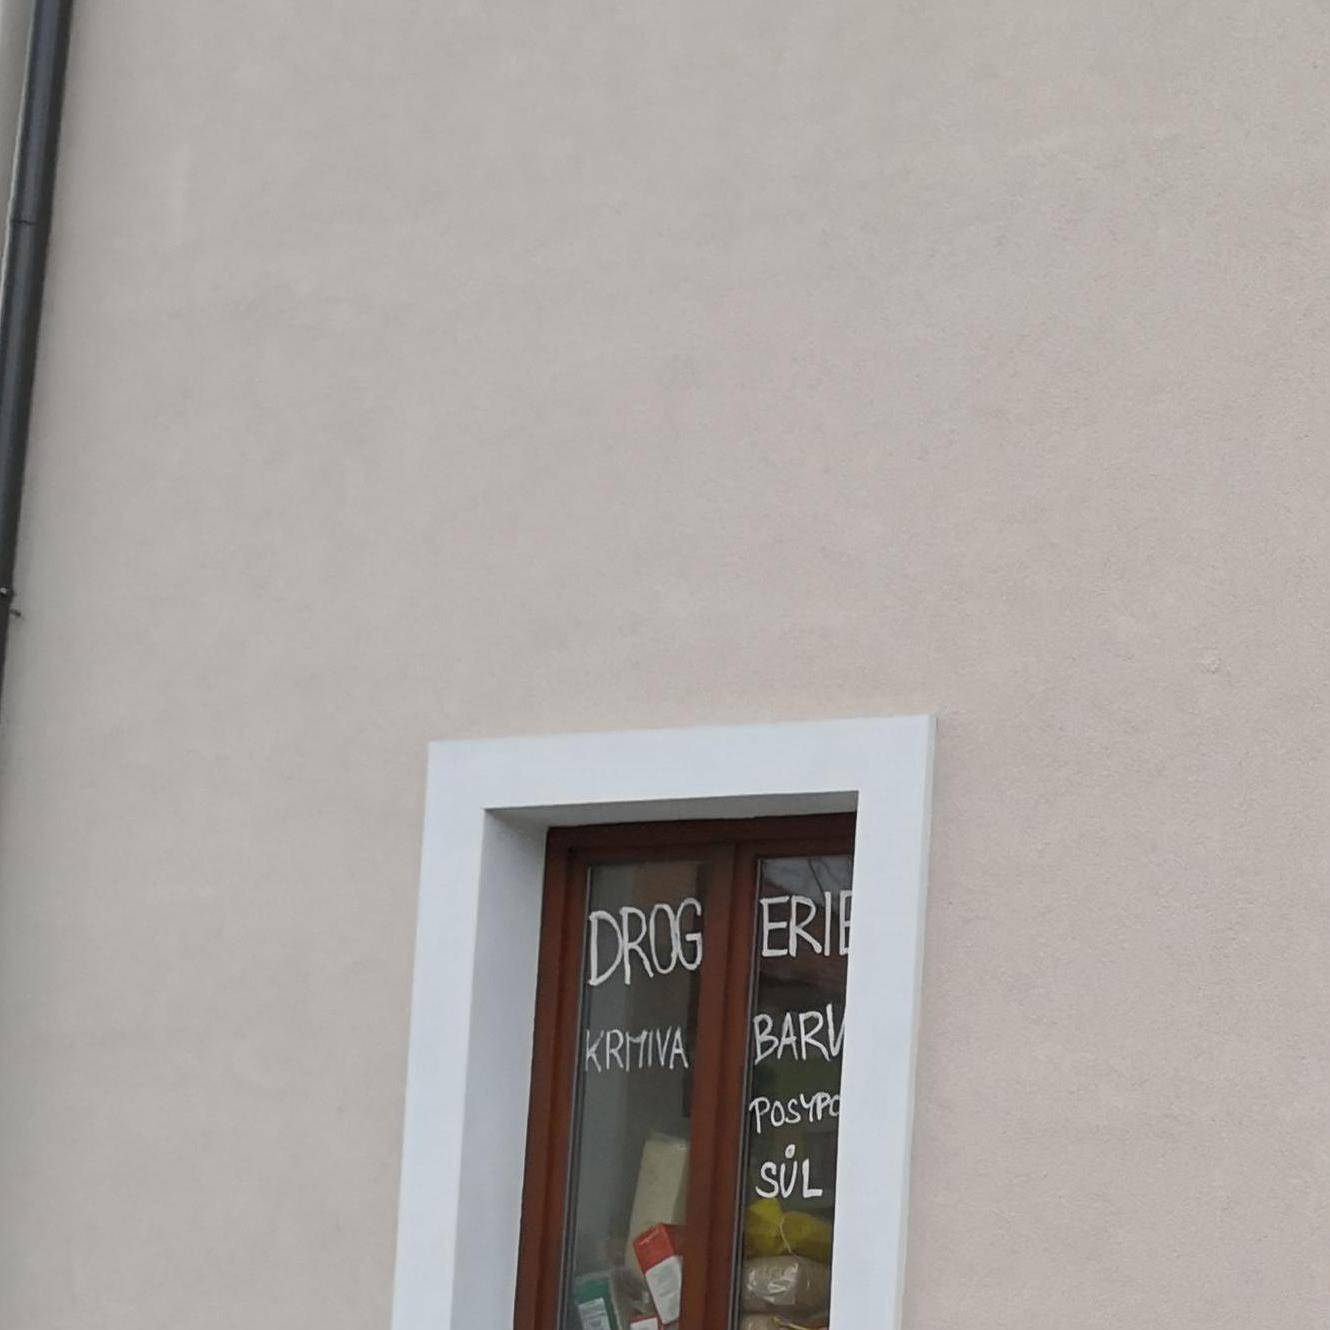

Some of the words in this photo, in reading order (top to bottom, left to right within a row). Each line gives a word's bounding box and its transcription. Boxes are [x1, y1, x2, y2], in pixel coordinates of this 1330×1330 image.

[588, 897, 703, 986] DROG
[760, 890, 852, 957] ERIE
[585, 1026, 689, 1072] KRMIVA
[755, 1144, 823, 1198] SŮL
